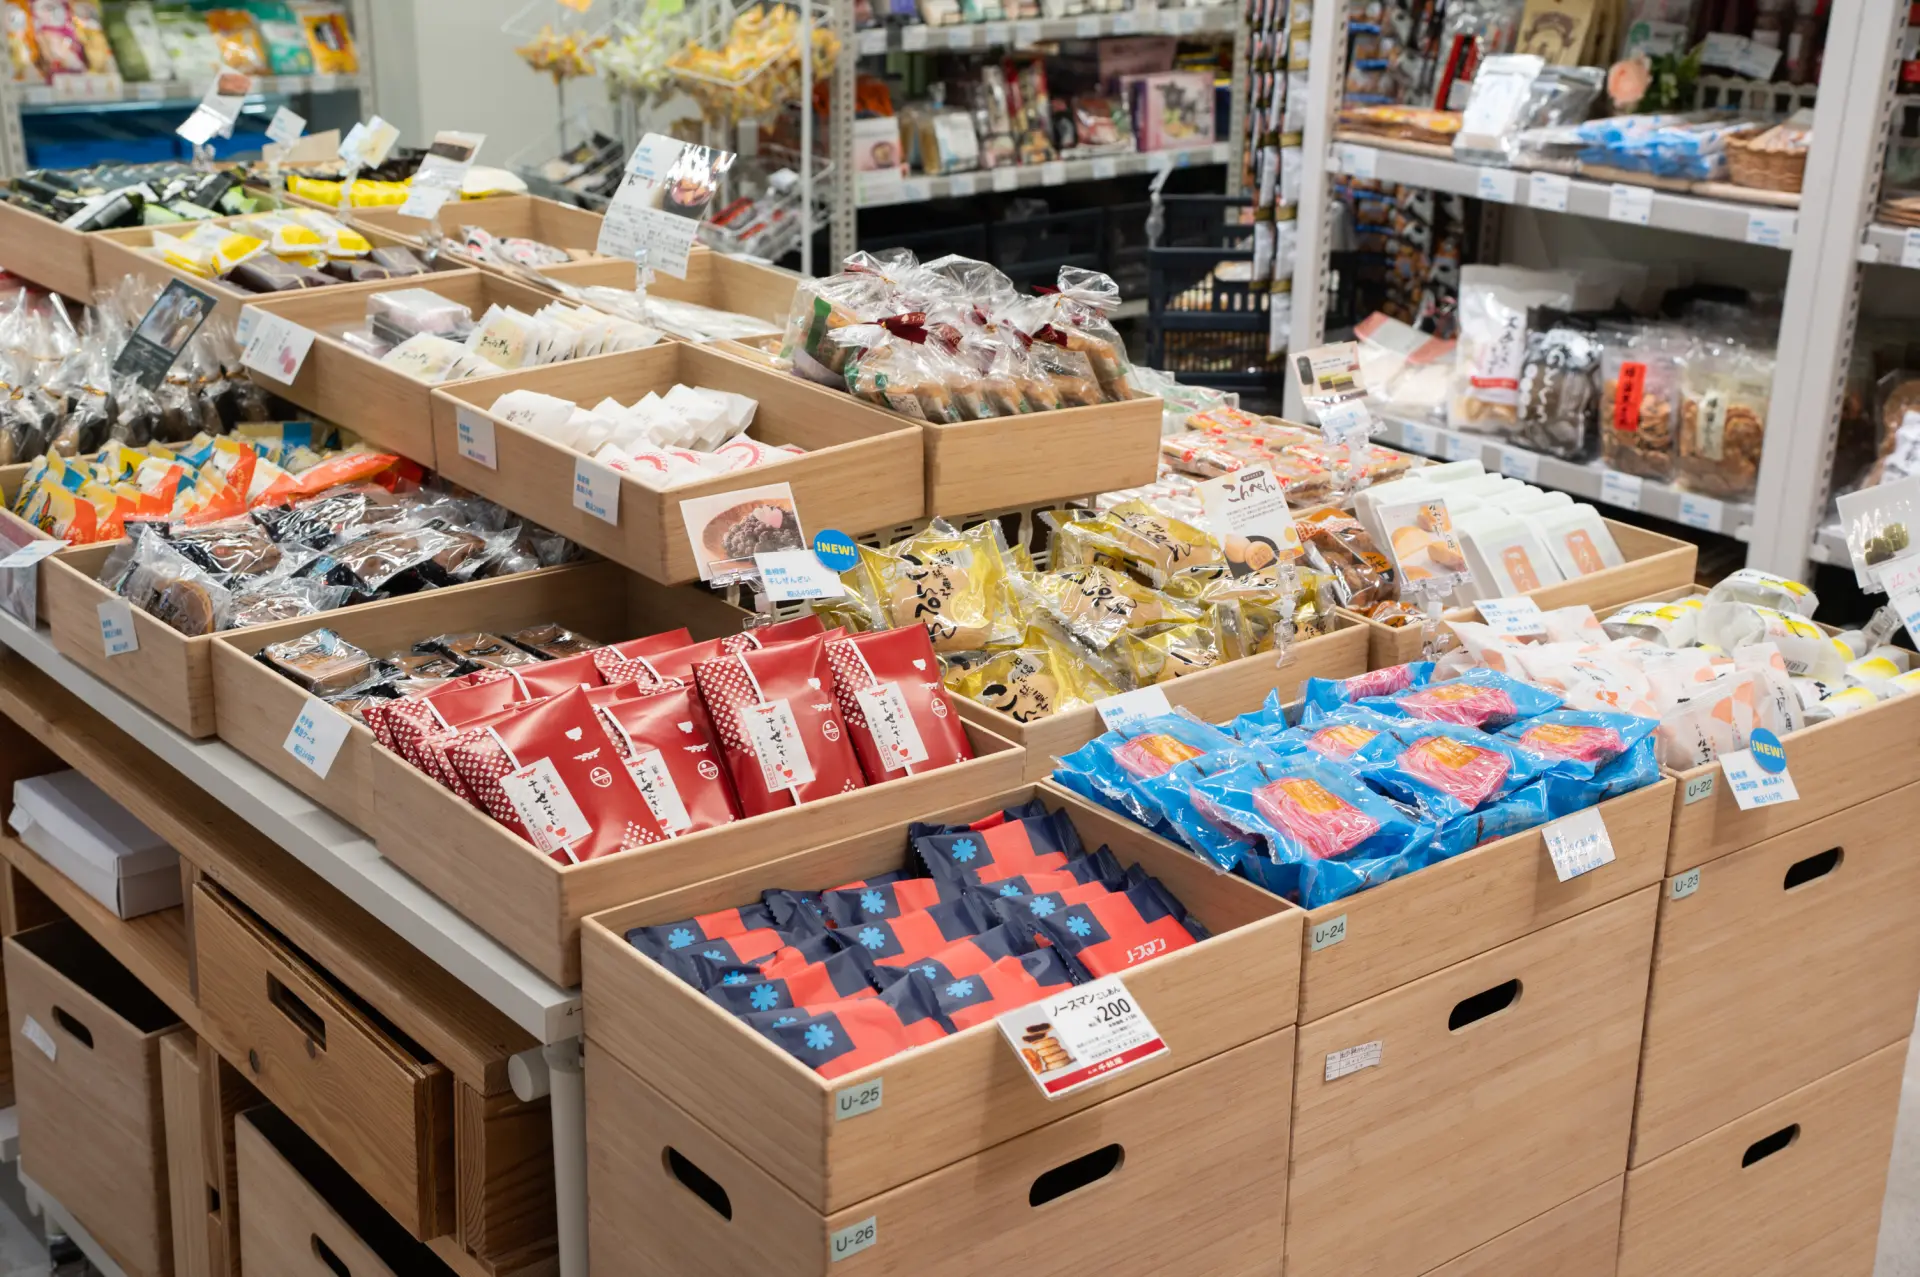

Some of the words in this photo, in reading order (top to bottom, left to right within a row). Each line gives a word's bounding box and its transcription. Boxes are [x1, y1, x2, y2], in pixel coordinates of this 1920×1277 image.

[1688, 781, 1712, 797] U-22
[1675, 874, 1699, 893] U-23
[1315, 922, 1345, 943] U-24
[1126, 938, 1167, 964] ノースマン
[1053, 992, 1095, 1018] ノースマン
[1097, 986, 1121, 1001] こしあん
[841, 1087, 880, 1111] U-25
[836, 1225, 874, 1252] U-26
